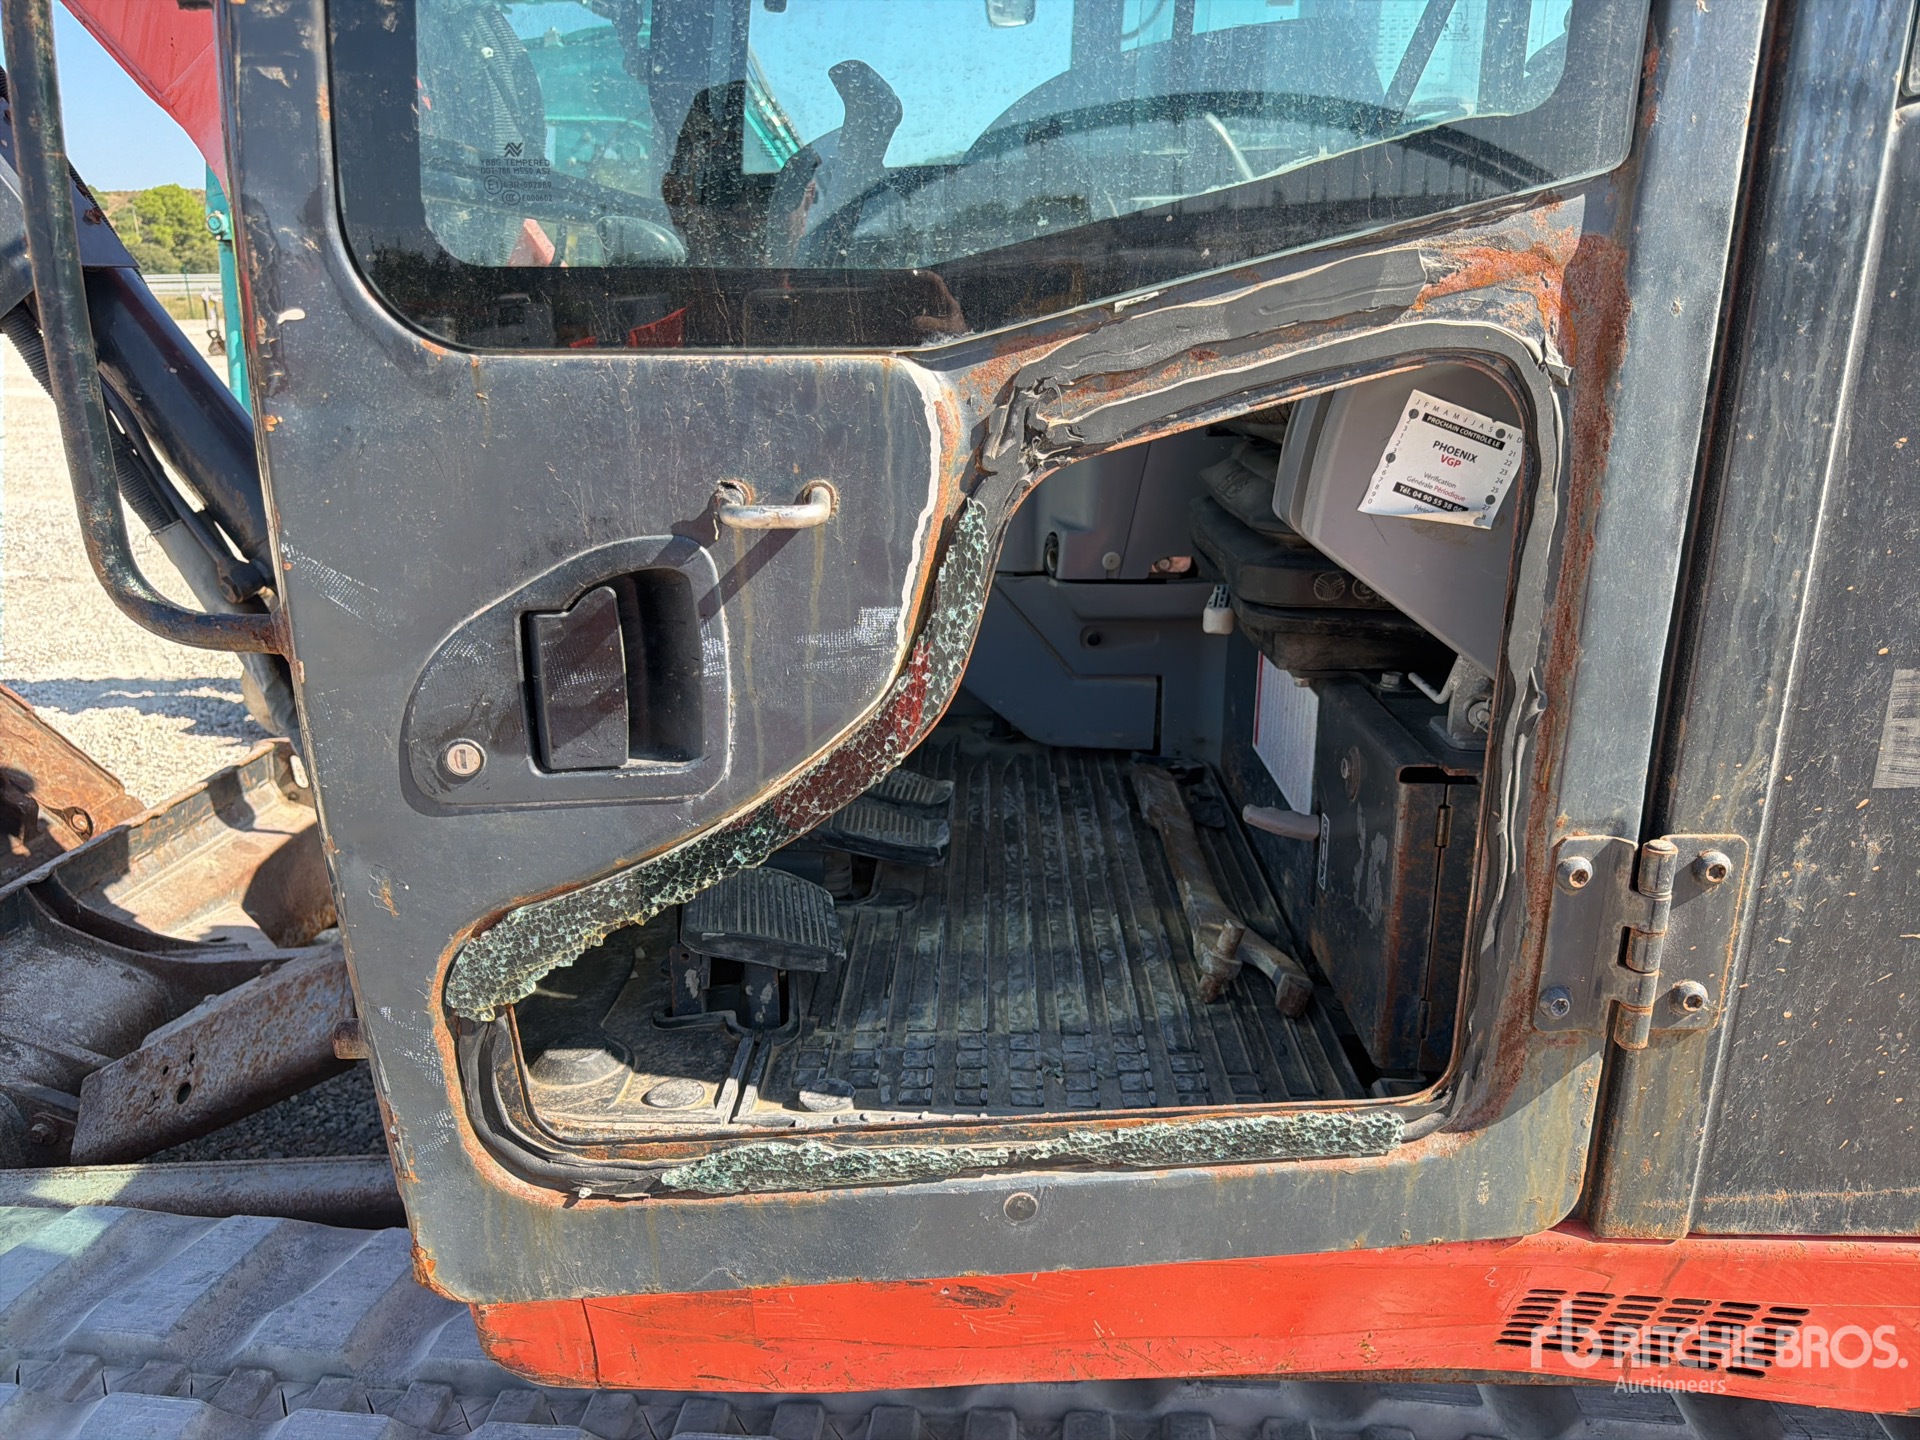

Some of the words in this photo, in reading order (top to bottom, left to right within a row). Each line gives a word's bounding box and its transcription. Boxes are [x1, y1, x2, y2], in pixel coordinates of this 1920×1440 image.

[505, 158, 550, 166] TEMPERED
[1426, 416, 1459, 432] PROCHAIN
[1459, 427, 1492, 444] CONTRÔLE
[1492, 439, 1501, 448] LE
[1432, 440, 1478, 464] PHOENIX
[1440, 454, 1462, 468] VGP
[1407, 476, 1433, 490] Générale
[1434, 485, 1466, 502] Périodique
[1424, 472, 1456, 489] Vérification
[1399, 485, 1411, 495] Tél.
[1412, 490, 1422, 498] 04
